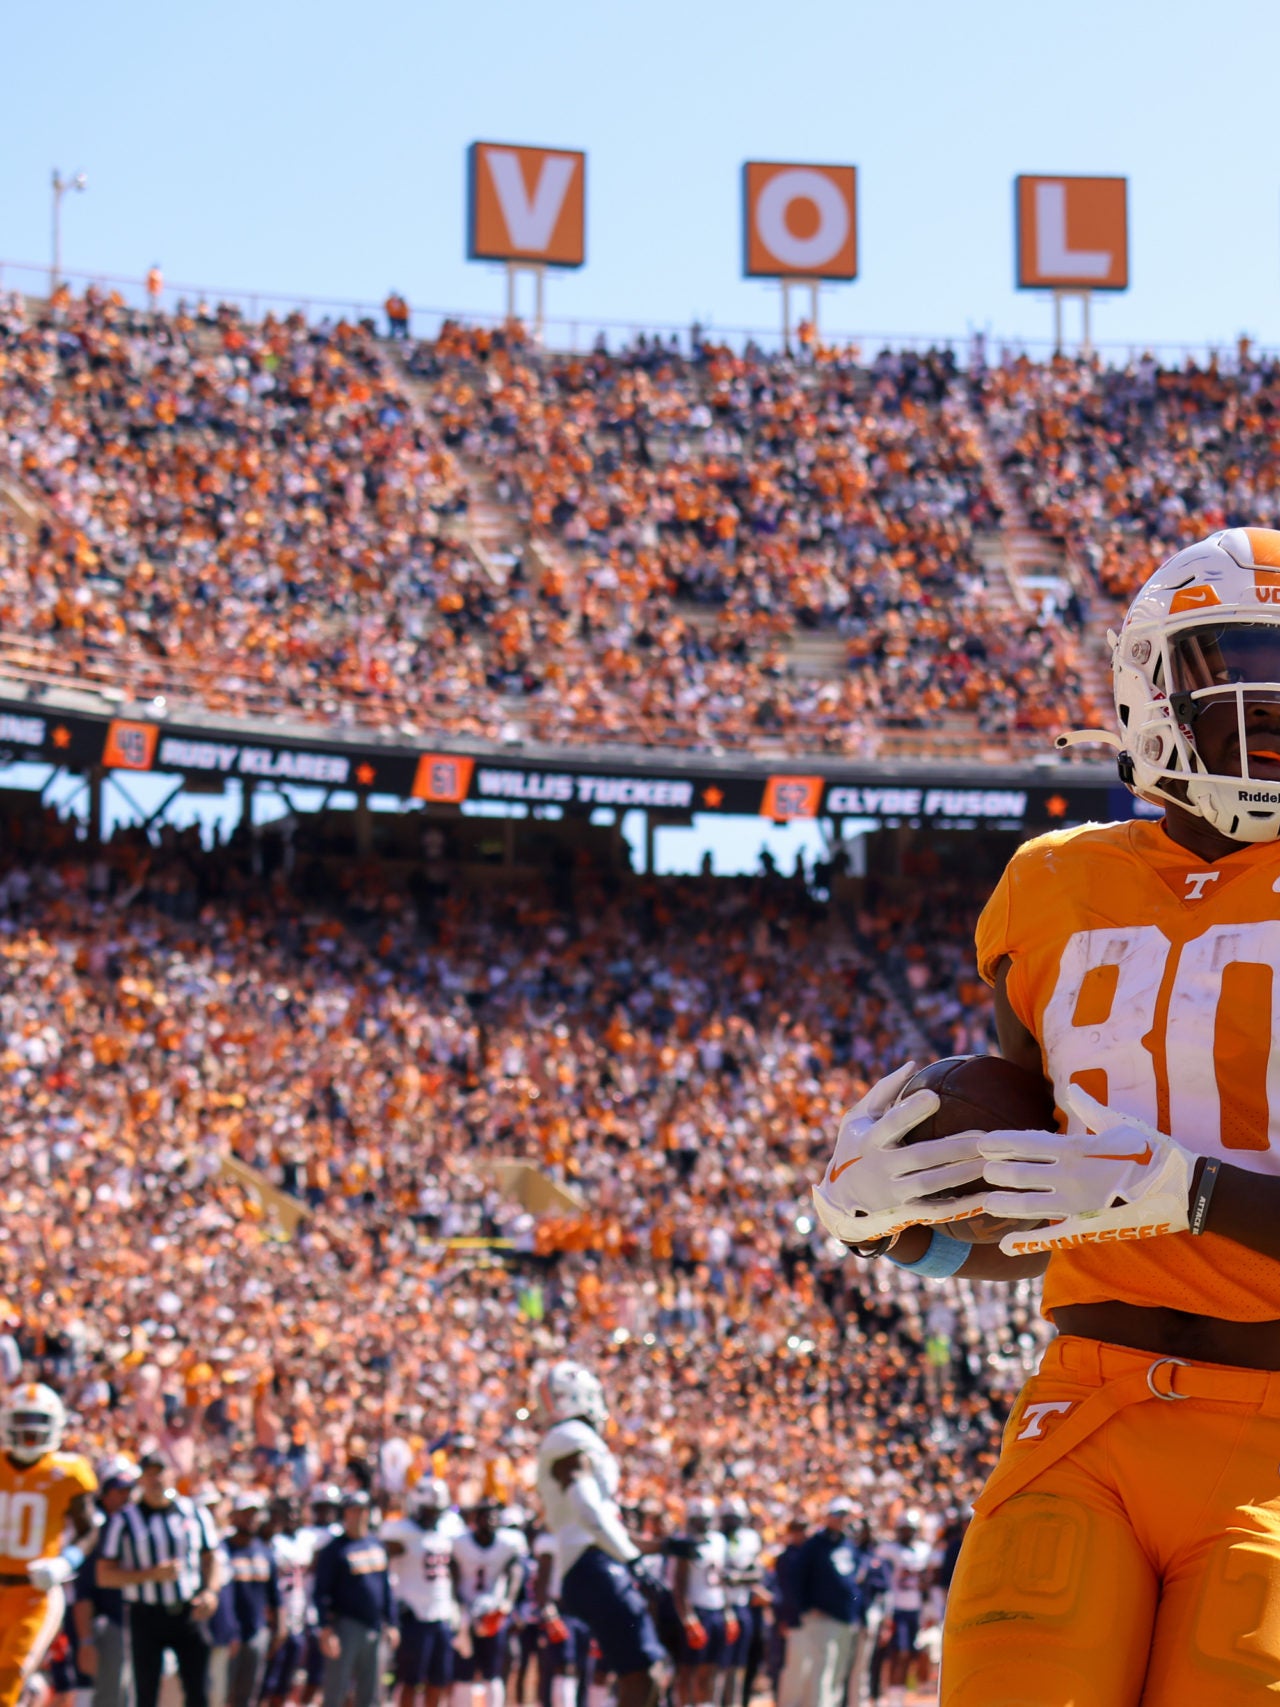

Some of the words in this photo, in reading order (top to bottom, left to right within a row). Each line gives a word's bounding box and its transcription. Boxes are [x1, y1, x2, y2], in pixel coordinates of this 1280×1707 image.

[477, 769, 574, 801] WILLIS
[575, 775, 694, 807] TUCKER
[827, 787, 923, 815] CLYDE
[923, 789, 1028, 818] FUSON
[1184, 871, 1220, 900] T
[1016, 1401, 1072, 1441] T
